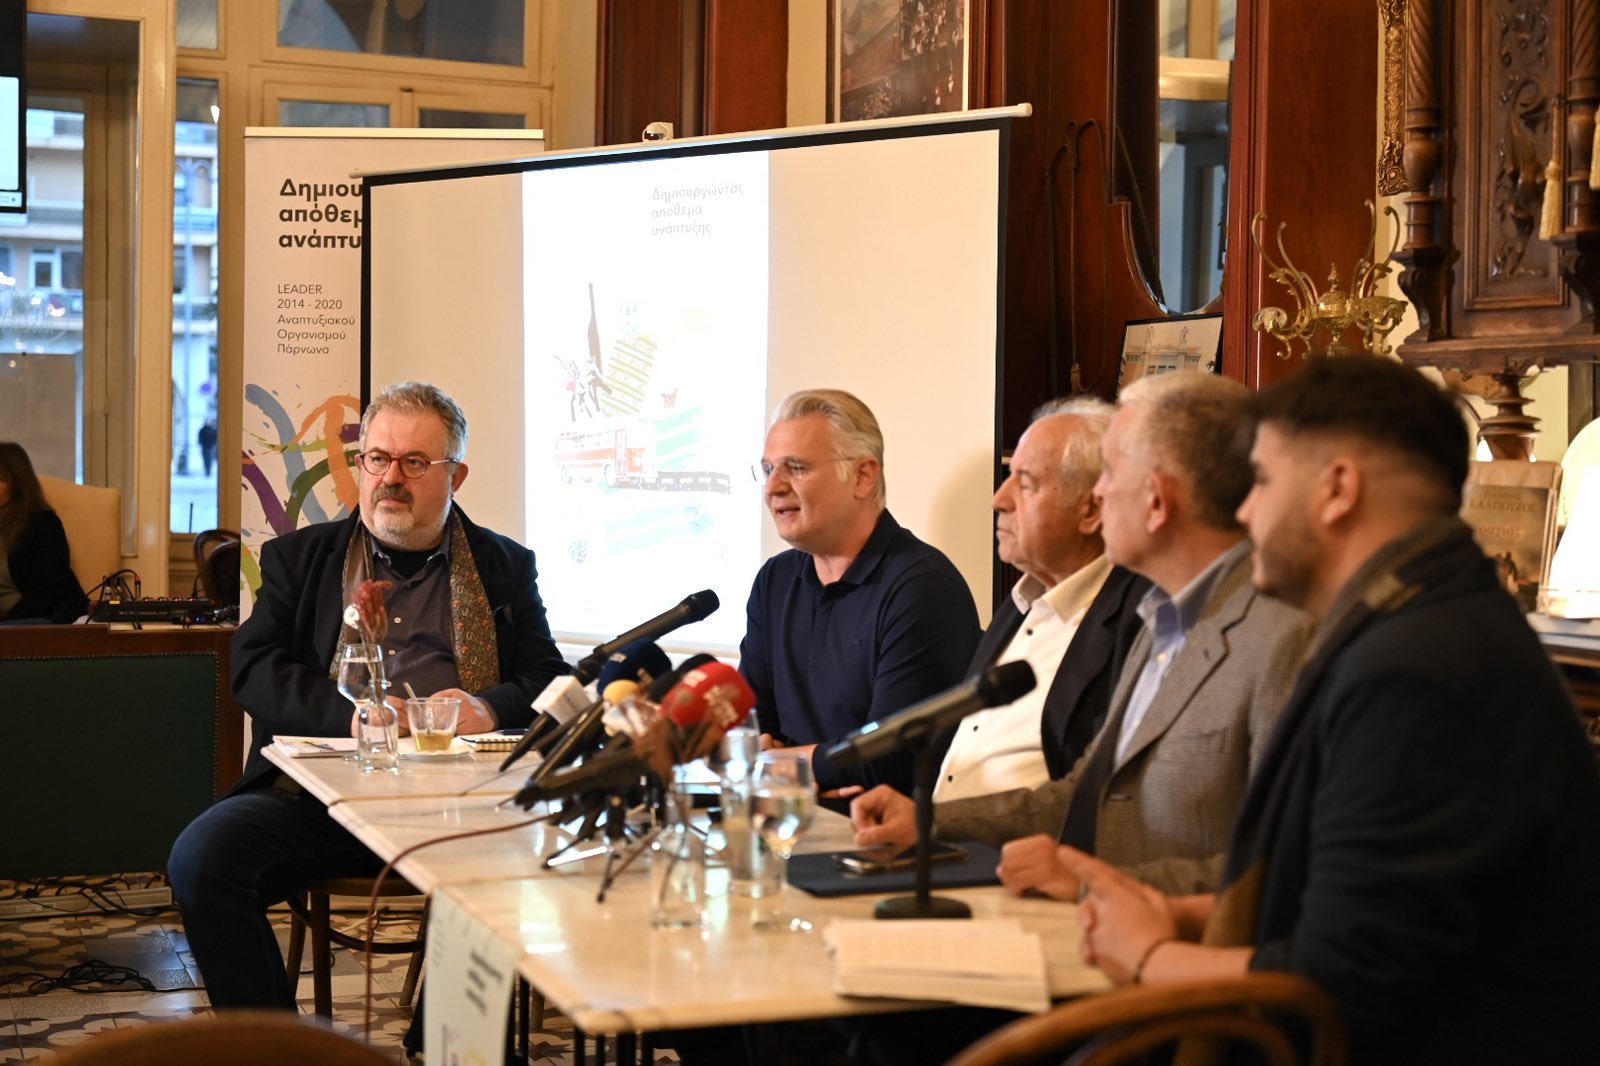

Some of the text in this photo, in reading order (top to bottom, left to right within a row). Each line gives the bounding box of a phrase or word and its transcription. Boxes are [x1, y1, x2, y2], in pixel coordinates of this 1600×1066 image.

[652, 183, 744, 204] Δημιουργώντας
[651, 220, 712, 237] ανάπτυξης
[277, 284, 322, 294] LEADER
[277, 298, 305, 309] 2014
[315, 299, 343, 310] 2020
[277, 314, 355, 328] Αναπτυξιακού
[277, 328, 346, 342] Οργανισμού
[277, 343, 329, 356] Πάρνωνα
